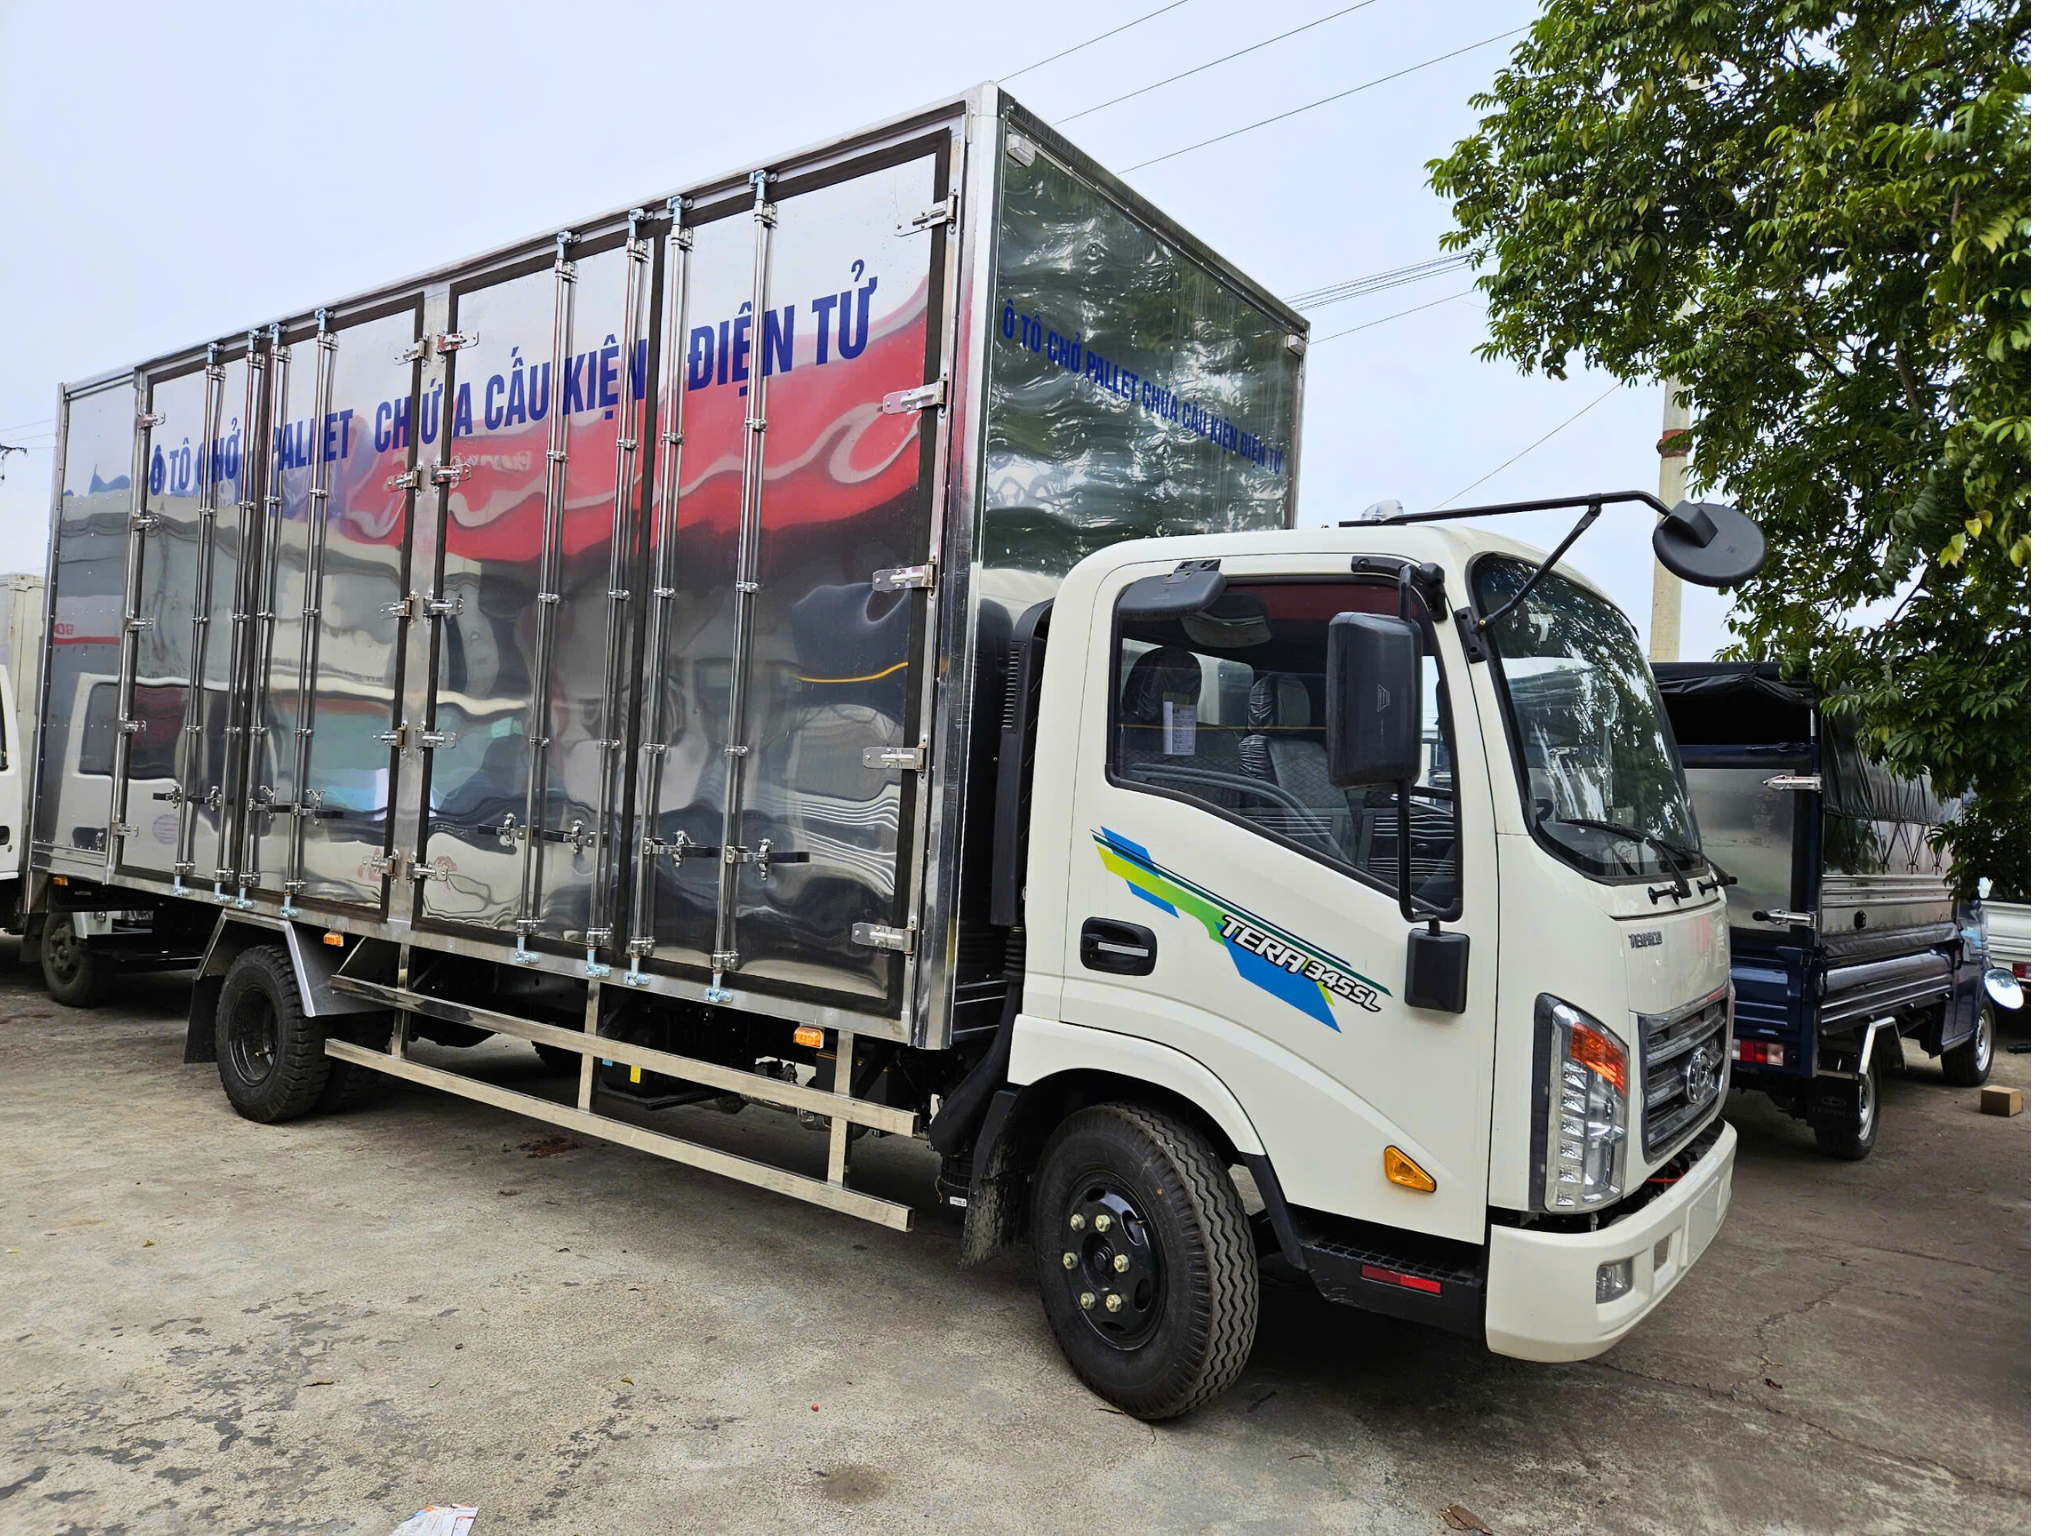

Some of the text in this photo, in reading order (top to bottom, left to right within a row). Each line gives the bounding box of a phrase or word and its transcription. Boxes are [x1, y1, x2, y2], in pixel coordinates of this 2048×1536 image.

[149, 444, 164, 496] Ô
[169, 437, 190, 490] TÔ
[484, 346, 551, 431] CẤU
[563, 333, 647, 420] KIỆN
[688, 301, 795, 397] ĐIỆN
[812, 259, 878, 366] TỬ
[1002, 298, 1015, 339] Ô
[1021, 314, 1042, 353] TÔ
[1085, 350, 1138, 402] PALLET
[1142, 380, 1178, 423] CHỨA
[1210, 416, 1238, 453] KIỆN
[1220, 914, 1308, 974] TERA
